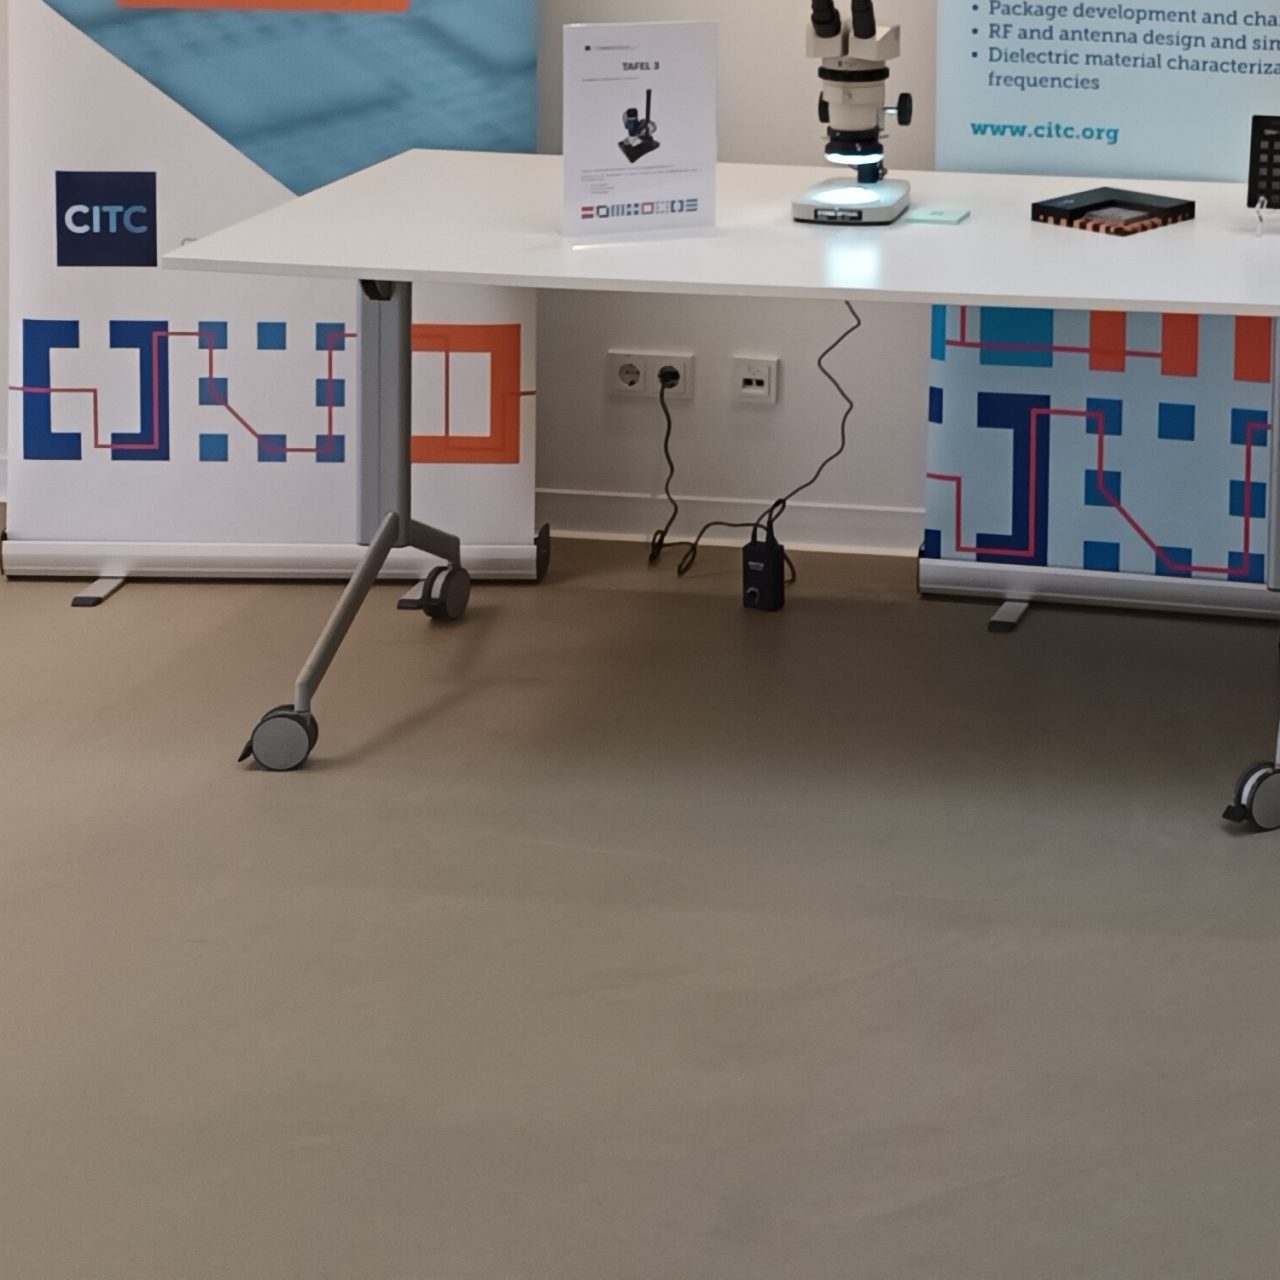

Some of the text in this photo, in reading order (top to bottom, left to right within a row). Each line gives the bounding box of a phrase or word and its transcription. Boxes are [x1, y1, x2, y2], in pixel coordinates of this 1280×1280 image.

[988, 0, 1068, 21] Package
[1073, 3, 1197, 24] development
[1202, 9, 1237, 26] and
[988, 24, 1012, 40] RF
[1018, 25, 1053, 41] and
[1059, 28, 1137, 44] antenna
[1143, 28, 1205, 49] design
[1211, 34, 1246, 50] and
[622, 62, 650, 71] TAFEL
[988, 47, 1079, 65] Dielectric
[1085, 51, 1162, 69] material
[988, 71, 1099, 93] frequencies
[970, 121, 1119, 144] www.citc.org
[64, 204, 148, 234] CITC
